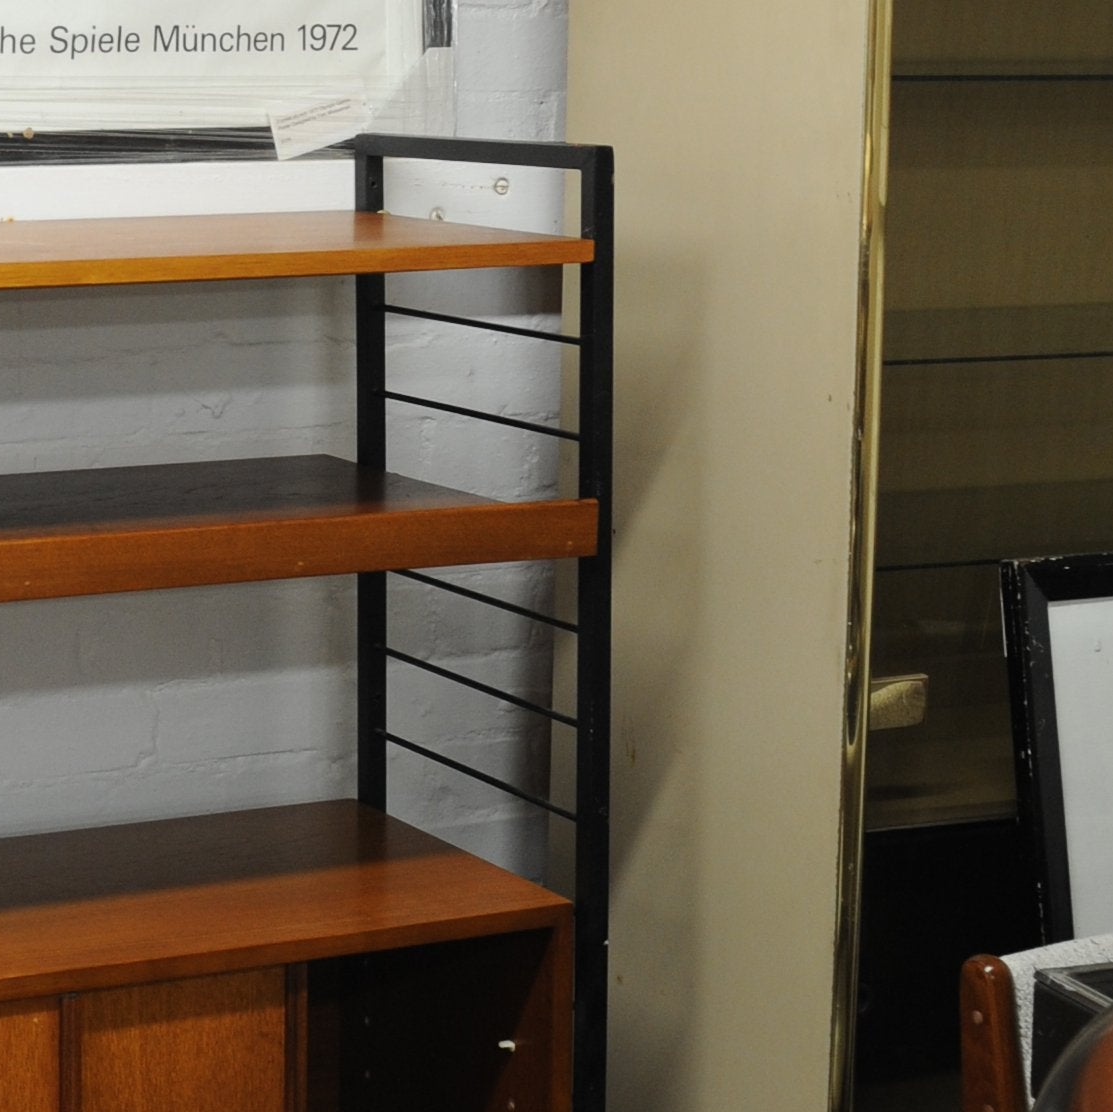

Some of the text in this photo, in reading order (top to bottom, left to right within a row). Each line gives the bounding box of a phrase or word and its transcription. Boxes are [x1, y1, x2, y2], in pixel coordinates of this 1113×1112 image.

[50, 26, 140, 59] Spiele
[153, 25, 285, 52] München
[298, 24, 358, 51] 1972
